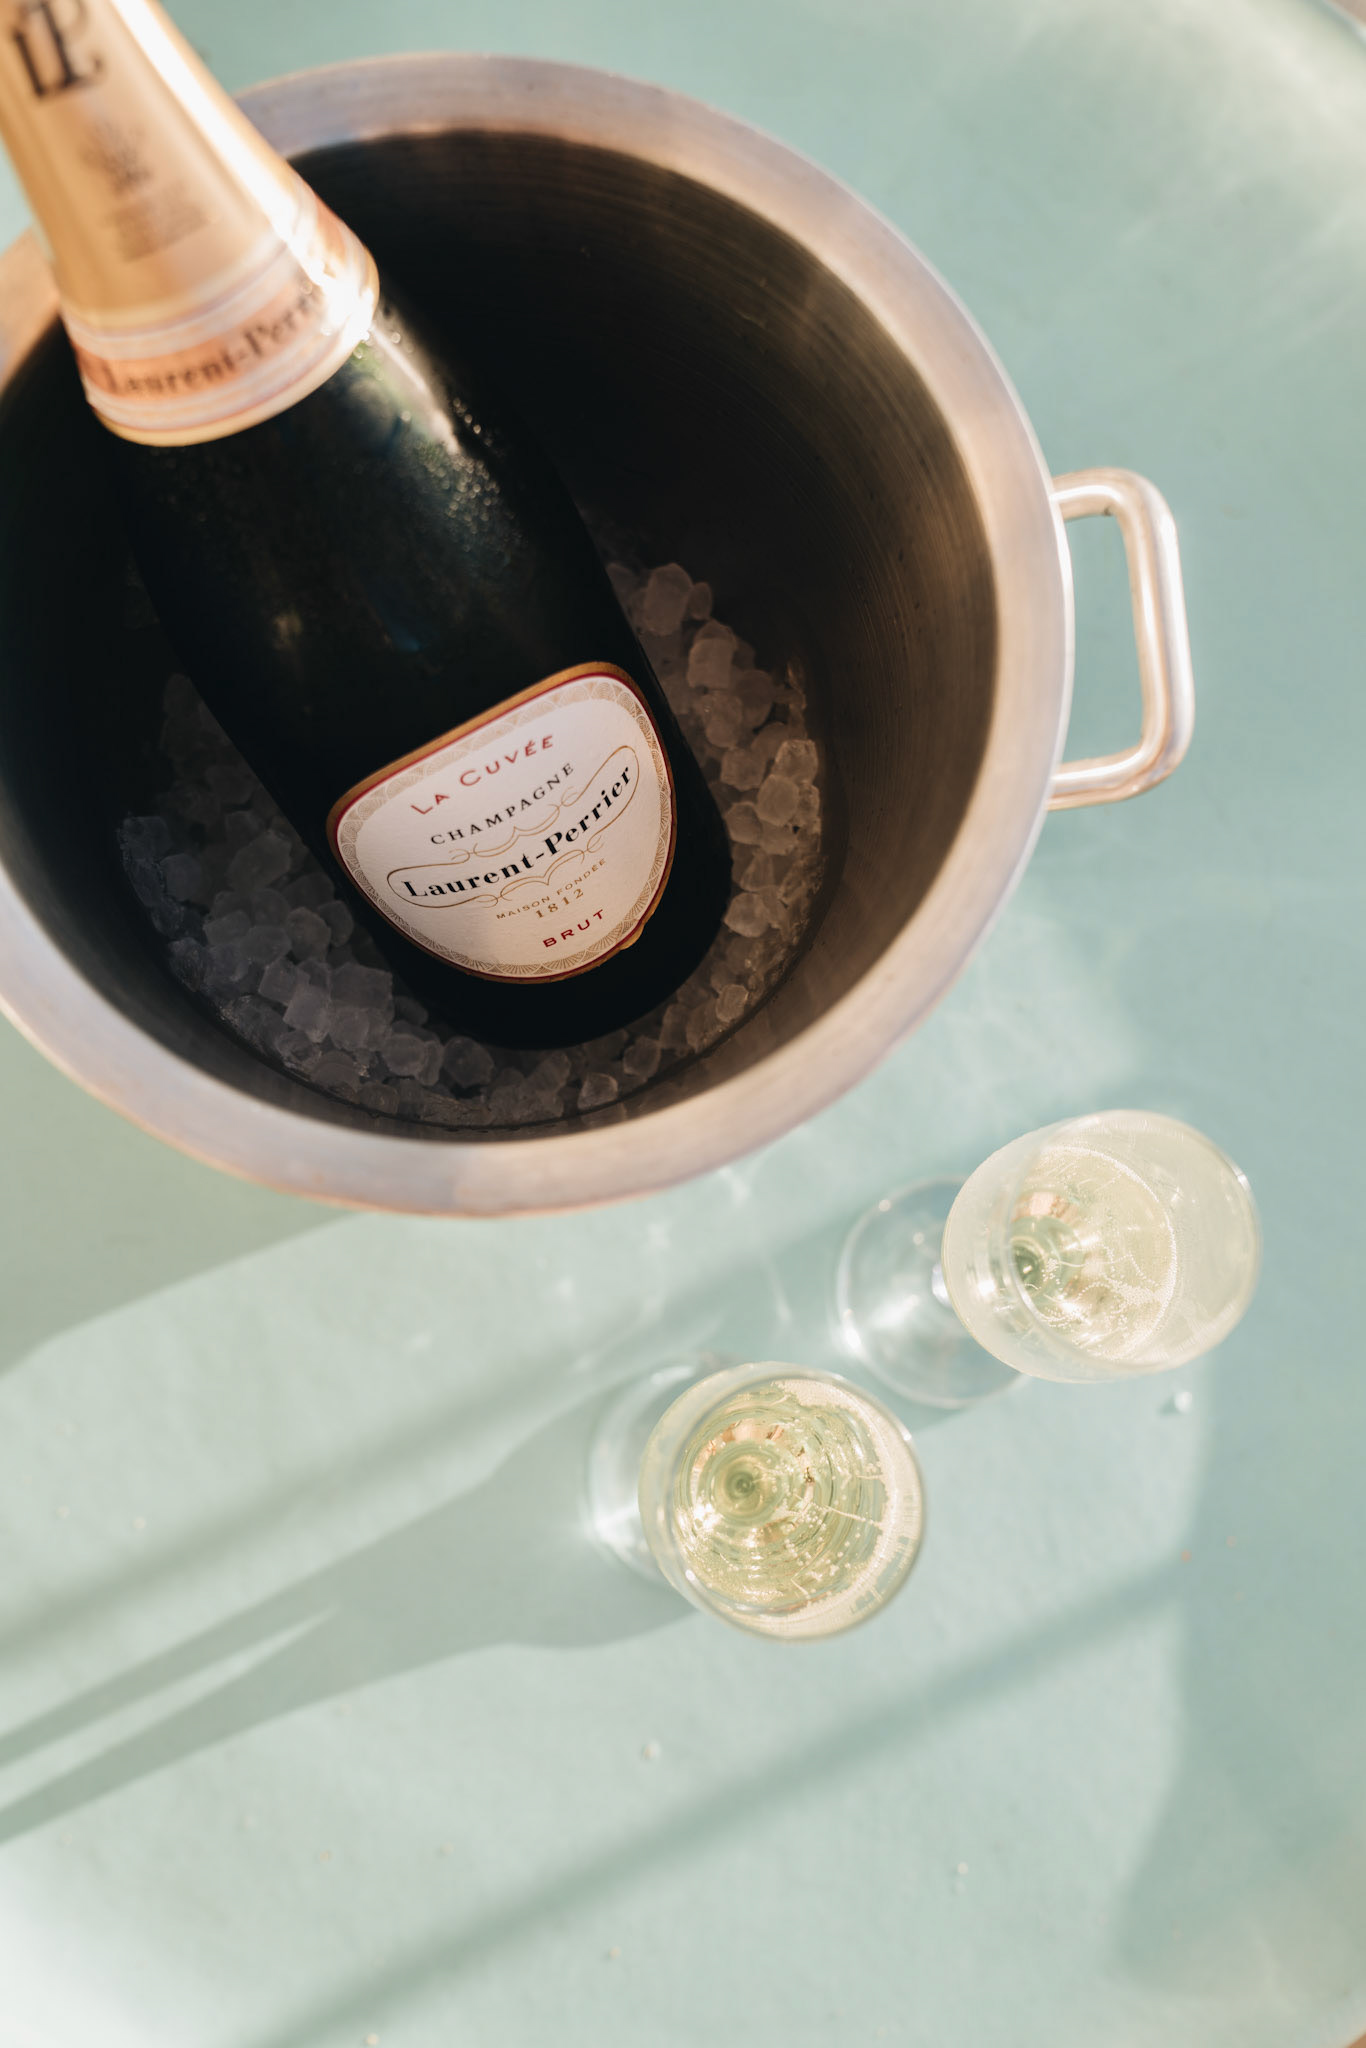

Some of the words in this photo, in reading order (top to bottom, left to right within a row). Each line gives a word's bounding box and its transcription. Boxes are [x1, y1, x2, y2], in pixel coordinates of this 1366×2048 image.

[459, 735, 554, 786] CUVÉE
[401, 766, 630, 898] Laurent-Perrier
[430, 763, 575, 845] CHAMPAGNE
[496, 895, 551, 920] MAISON
[556, 858, 606, 896] FONDÉE
[535, 888, 585, 919] 1812
[542, 908, 604, 948] BRUT
